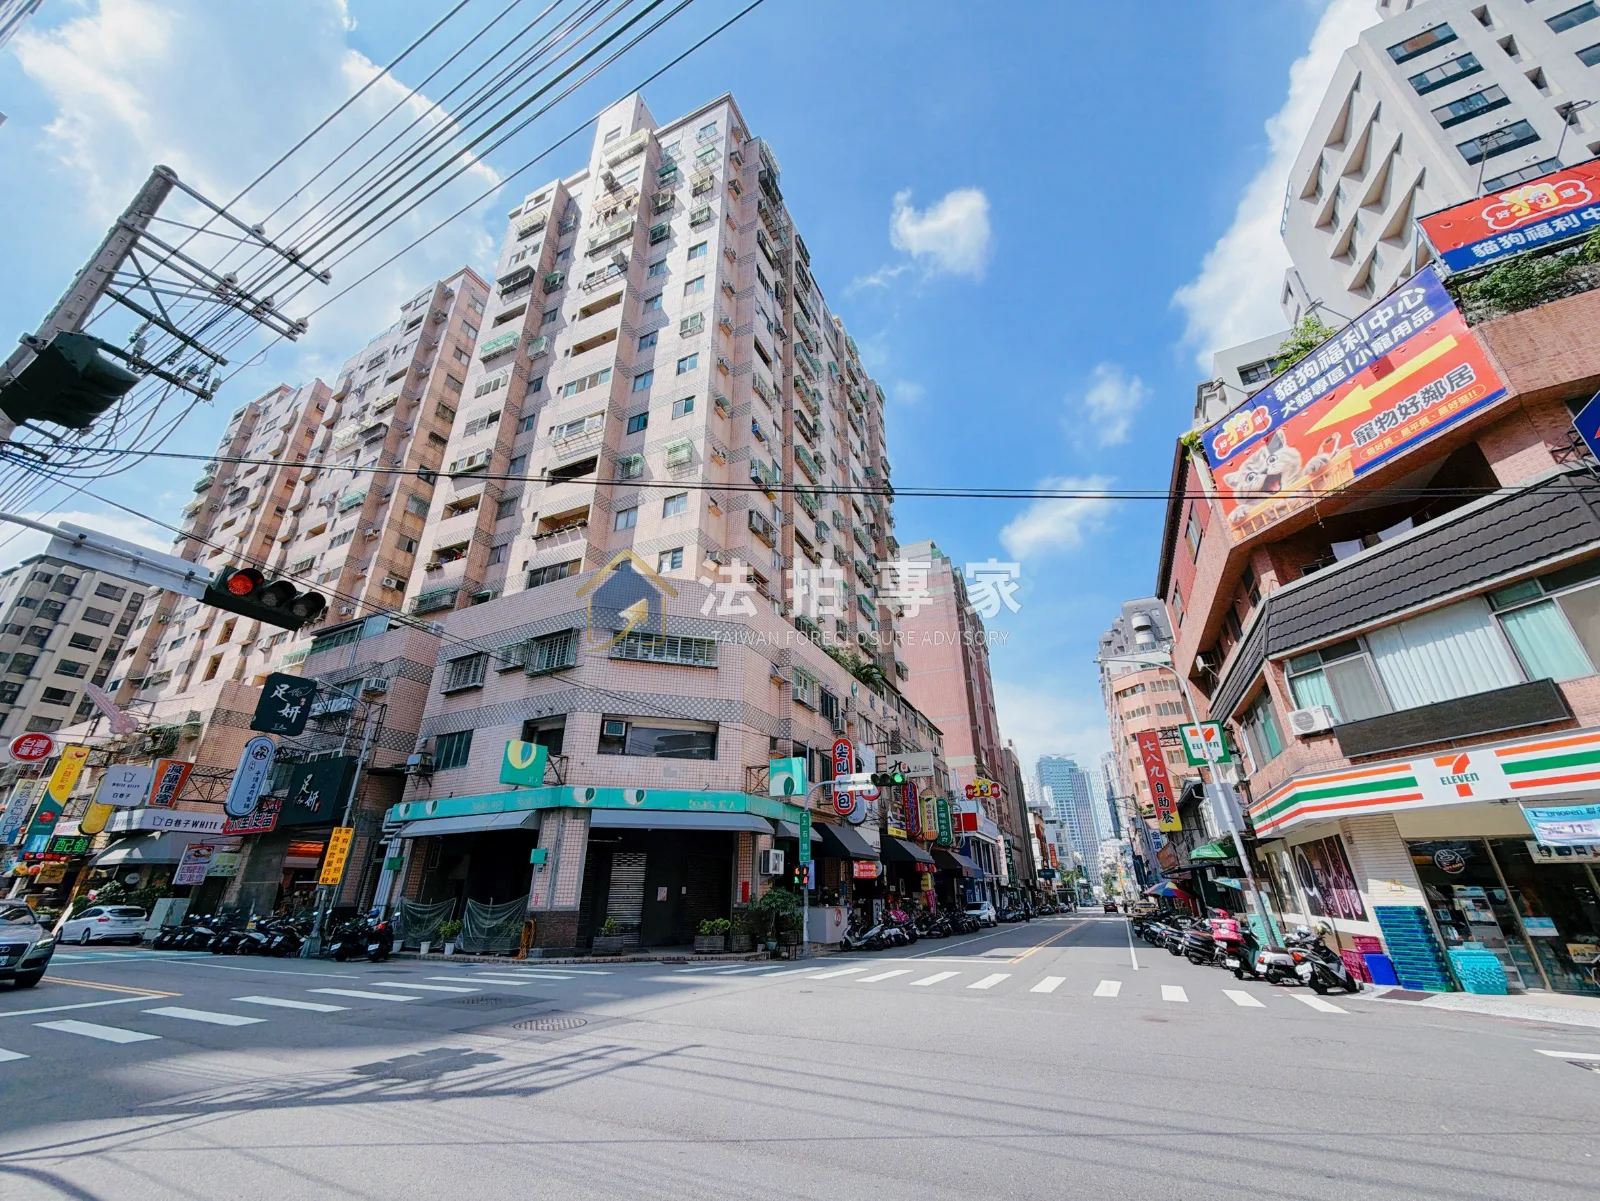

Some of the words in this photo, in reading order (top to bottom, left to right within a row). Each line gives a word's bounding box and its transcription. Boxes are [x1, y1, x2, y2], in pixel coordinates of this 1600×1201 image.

[1471, 207, 1600, 258] 貓狗福利中
[1273, 286, 1426, 400] 貓狗福利中心
[1352, 363, 1477, 447] 寵物好鄰居
[21, 738, 49, 748] 台灣
[155, 763, 185, 804] 減醣便當
[836, 743, 851, 809] 尖叫包
[1143, 739, 1174, 825] 七八九自助餐
[164, 819, 191, 828] 白巷子
